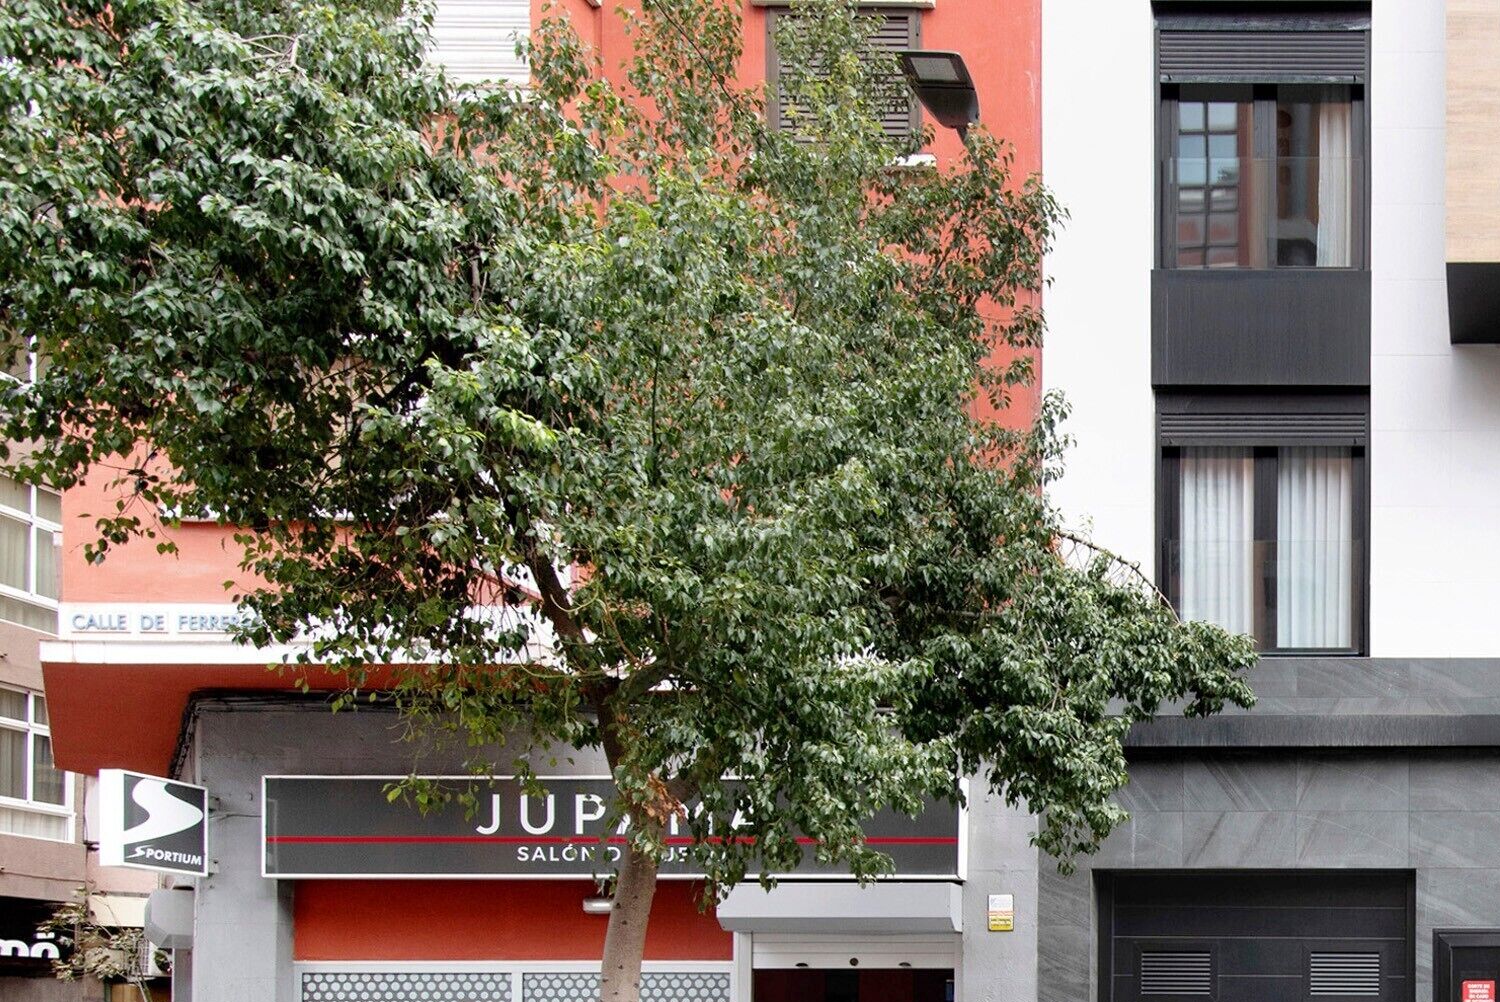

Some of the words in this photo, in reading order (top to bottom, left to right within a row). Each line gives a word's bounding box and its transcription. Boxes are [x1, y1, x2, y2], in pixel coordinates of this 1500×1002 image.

[72, 614, 127, 630] CALLE
[140, 615, 165, 630] DE
[125, 844, 202, 866] SPORTIUM
[517, 843, 596, 862] SALÓN
